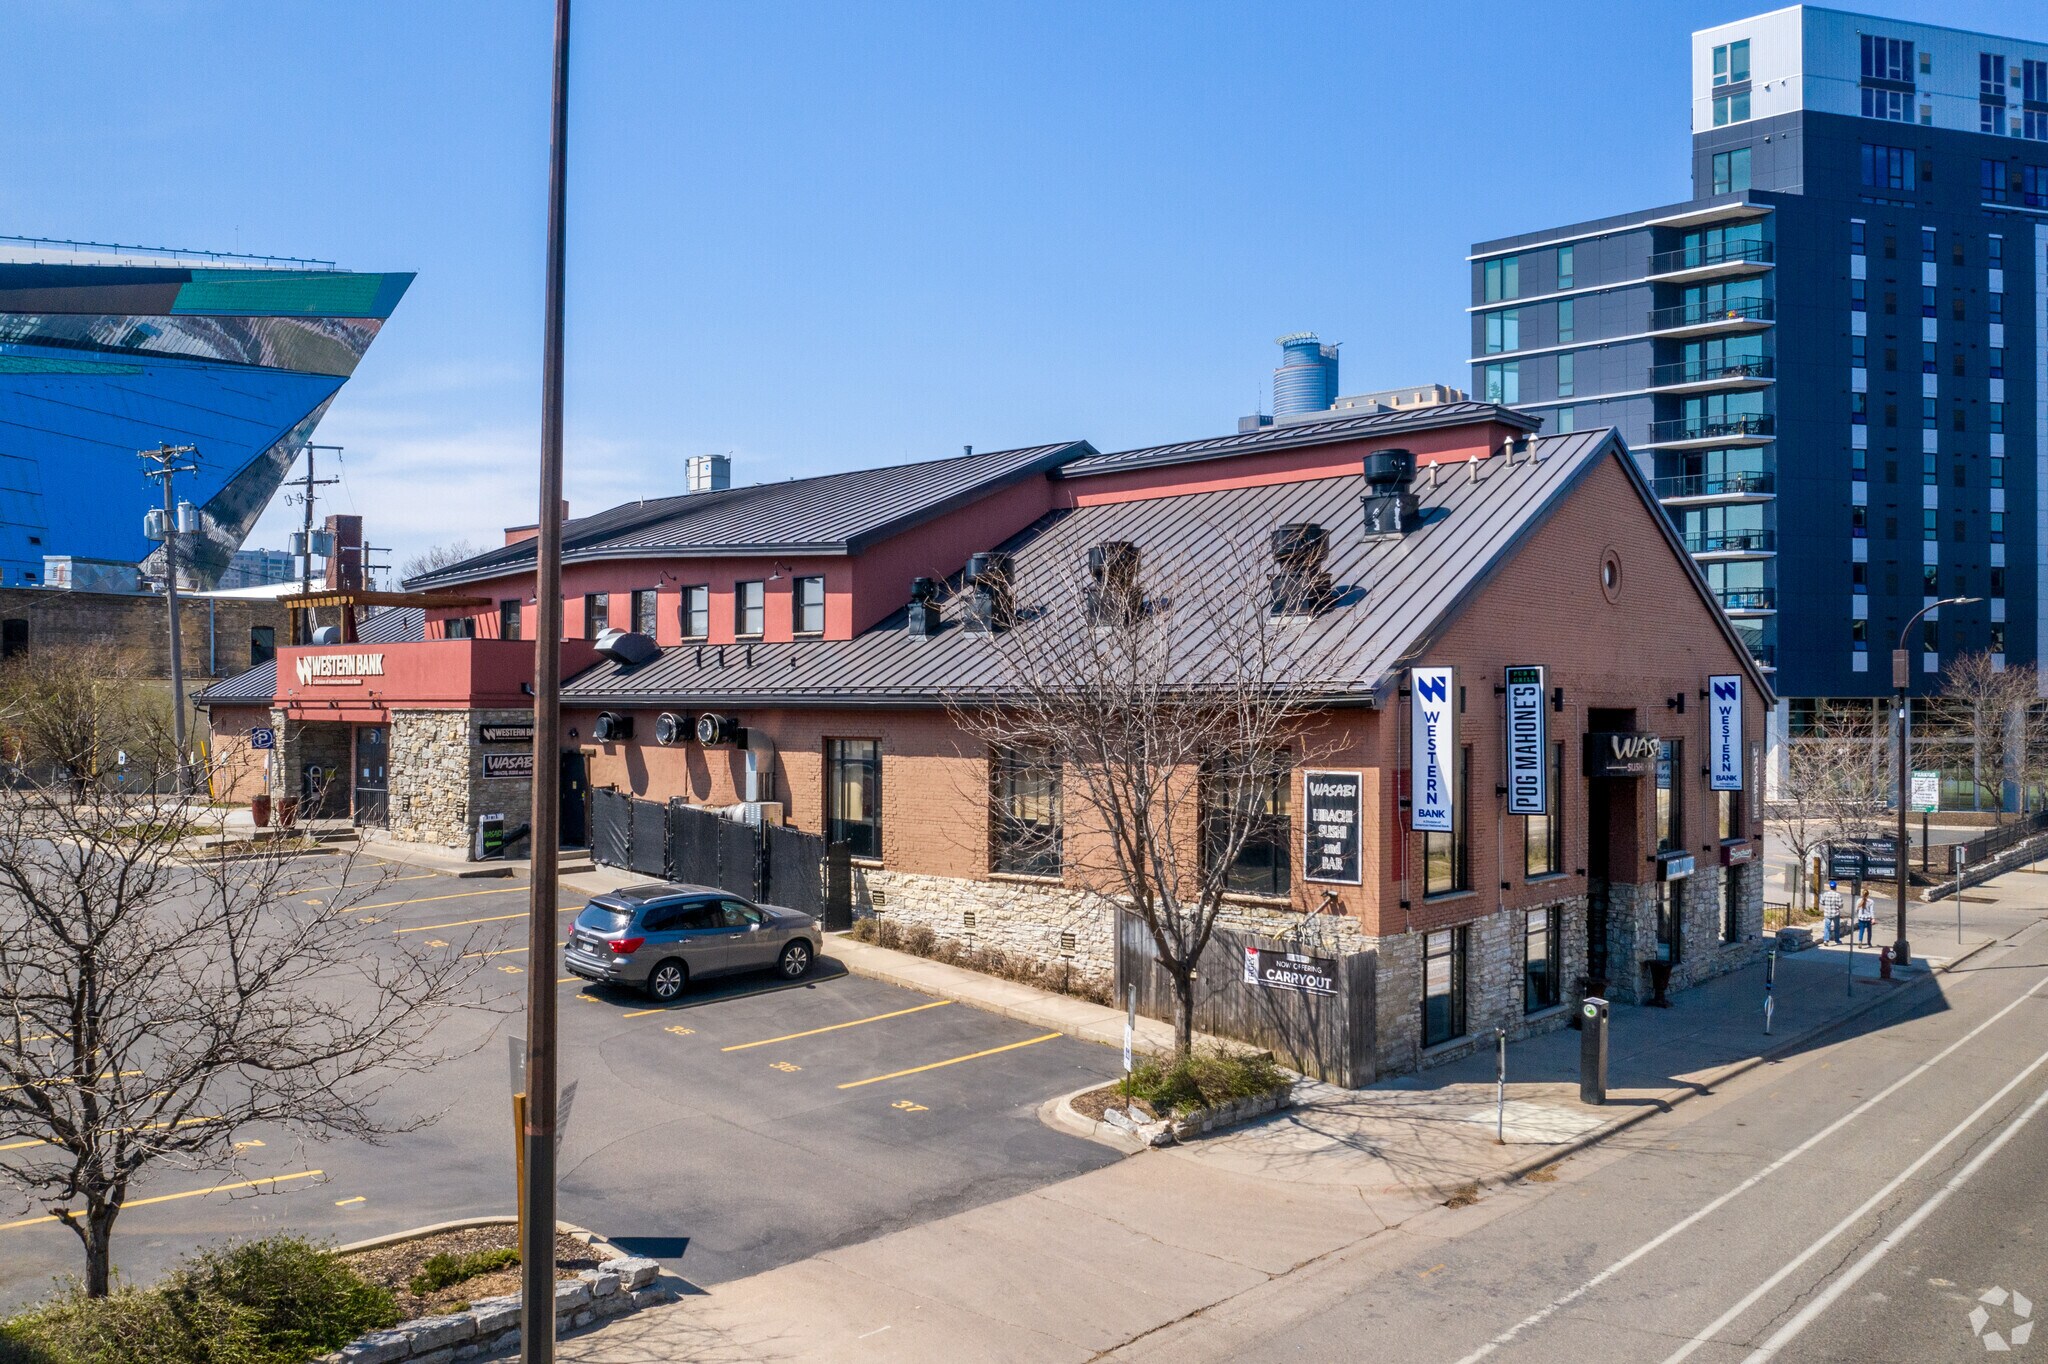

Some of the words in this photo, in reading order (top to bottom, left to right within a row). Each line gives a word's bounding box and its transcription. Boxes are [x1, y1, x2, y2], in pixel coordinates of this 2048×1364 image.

[312, 655, 355, 676] WESTERN
[356, 654, 384, 675] BANK
[495, 728, 526, 737] WESTERN
[526, 728, 534, 736] BA
[1513, 686, 1537, 770] MAHONE'S
[1719, 706, 1732, 772] WESTERN
[488, 756, 533, 770] WASAB
[1424, 711, 1440, 805] WESTERN
[1310, 782, 1357, 798] WASABI
[1516, 775, 1538, 807] POG
[1312, 808, 1353, 823] HIBACHI
[1418, 809, 1446, 818] BANK
[1318, 824, 1347, 839] SUSHI
[1323, 842, 1341, 855] and
[1322, 856, 1344, 871] BAR
[1276, 960, 1291, 968] NOW
[1266, 968, 1332, 989] CARRYOUT
[769, 1061, 802, 1073] 36
